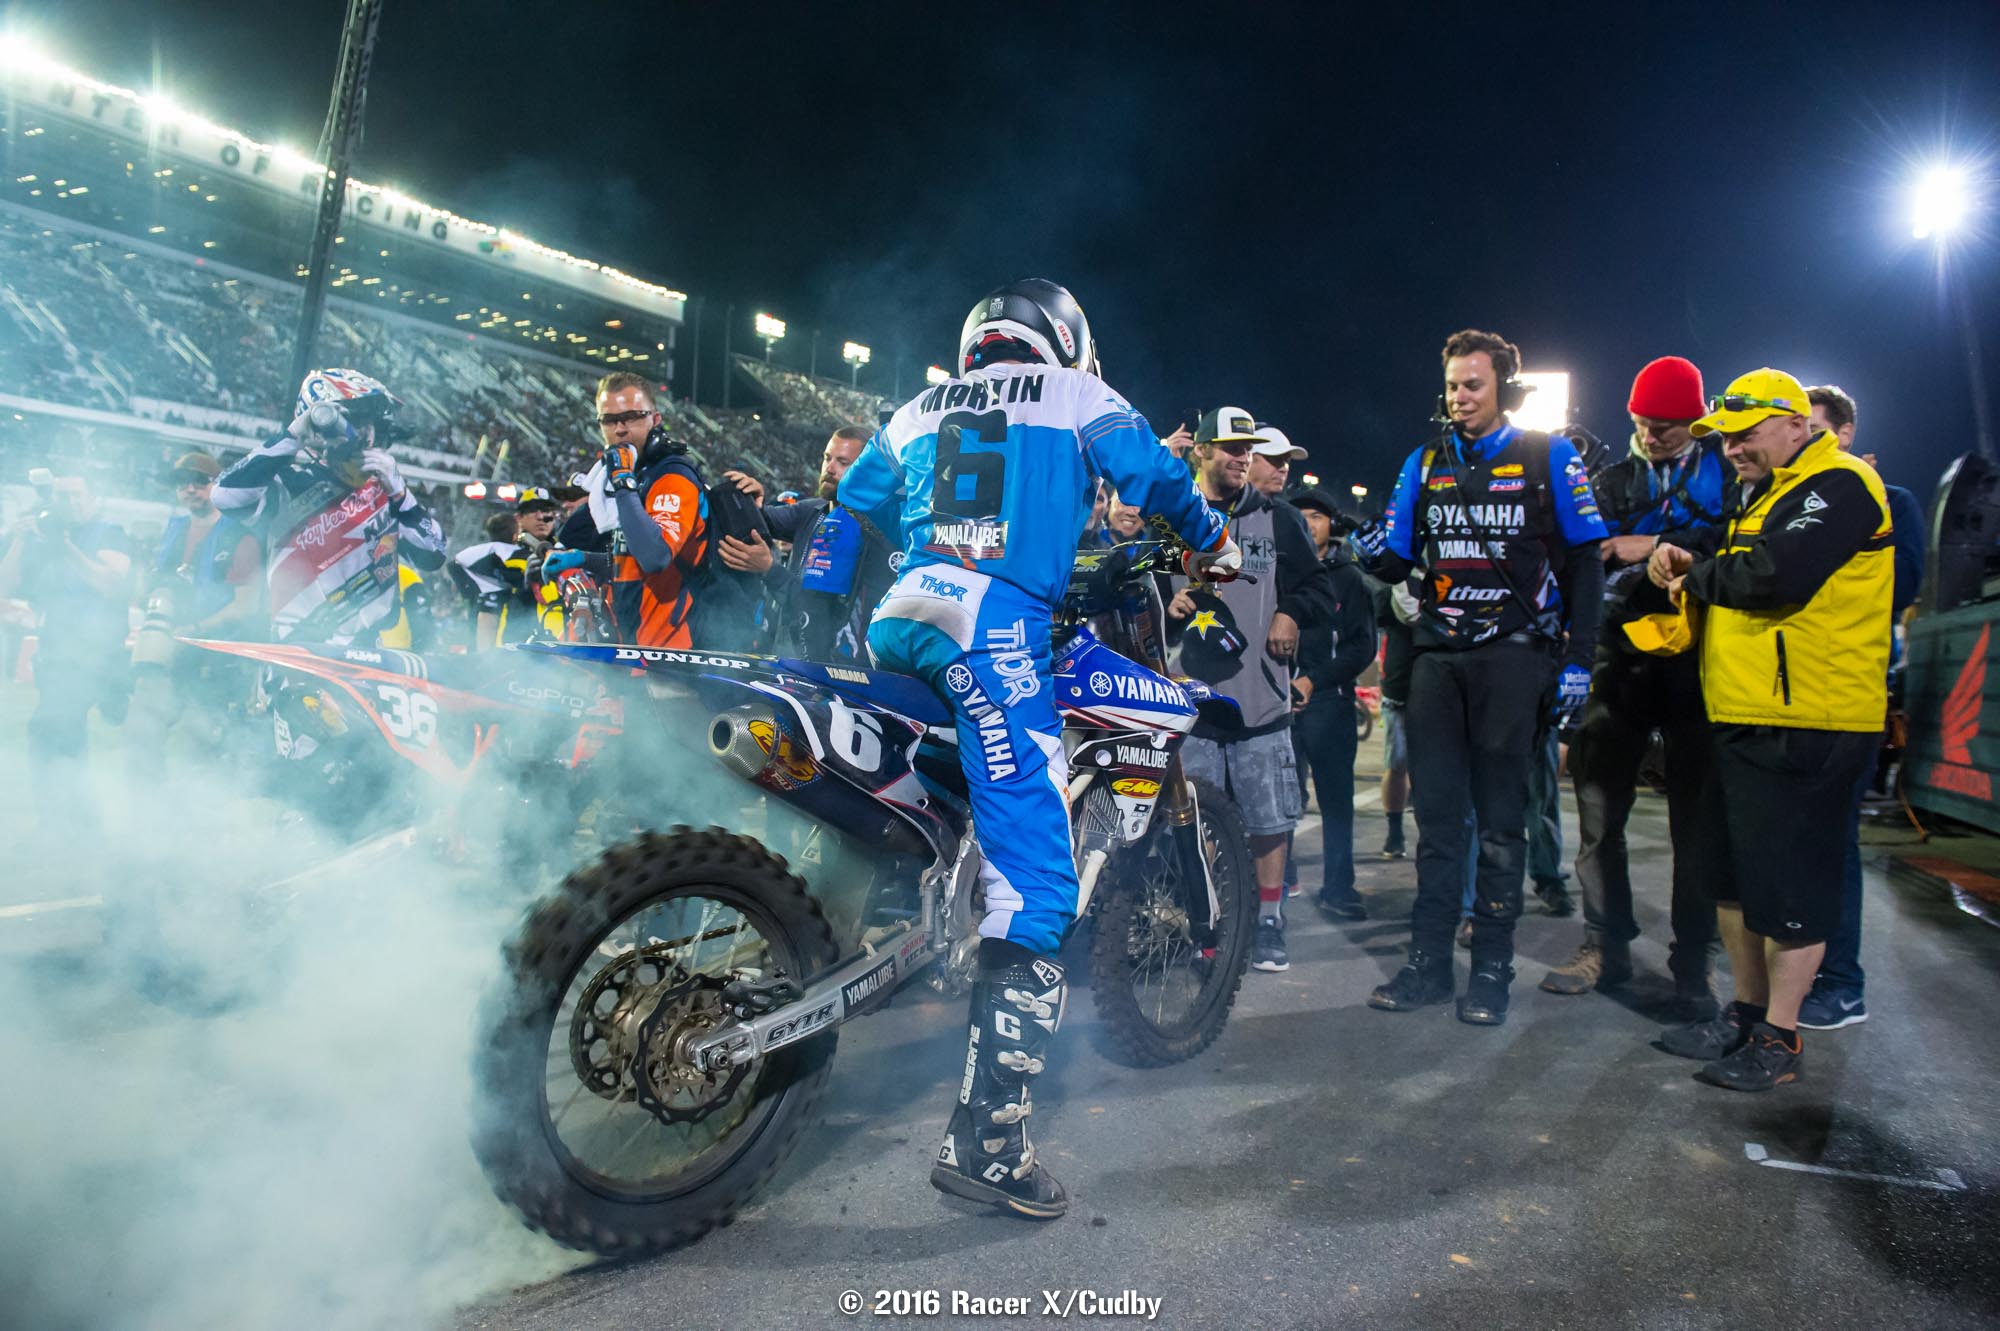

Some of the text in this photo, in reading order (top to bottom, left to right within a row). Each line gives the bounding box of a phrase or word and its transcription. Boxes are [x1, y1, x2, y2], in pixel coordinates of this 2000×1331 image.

[301, 172, 449, 240] RCING
[1057, 325, 1073, 351] BELL
[920, 374, 1045, 415] MARTIN
[931, 409, 1008, 519] 6
[933, 523, 1001, 547] YAMALUBE
[1430, 528, 1520, 536] RACNG
[1438, 540, 1507, 559] YAMALBE
[919, 574, 968, 602] THOR
[1448, 586, 1511, 601] thor
[615, 648, 751, 669] DUNLOP
[986, 618, 1041, 708] THOR
[825, 666, 871, 685] YAMAHA
[507, 681, 584, 709] GoPro
[1113, 674, 1190, 708] YAMAHA
[377, 684, 438, 750] 36
[829, 694, 883, 773] 6
[962, 687, 1017, 782] YAMAHA
[1116, 744, 1171, 769] YAMALUBE
[846, 961, 895, 1006] YAMALUBE
[767, 1003, 834, 1042] GYTR
[939, 1146, 951, 1160] G
